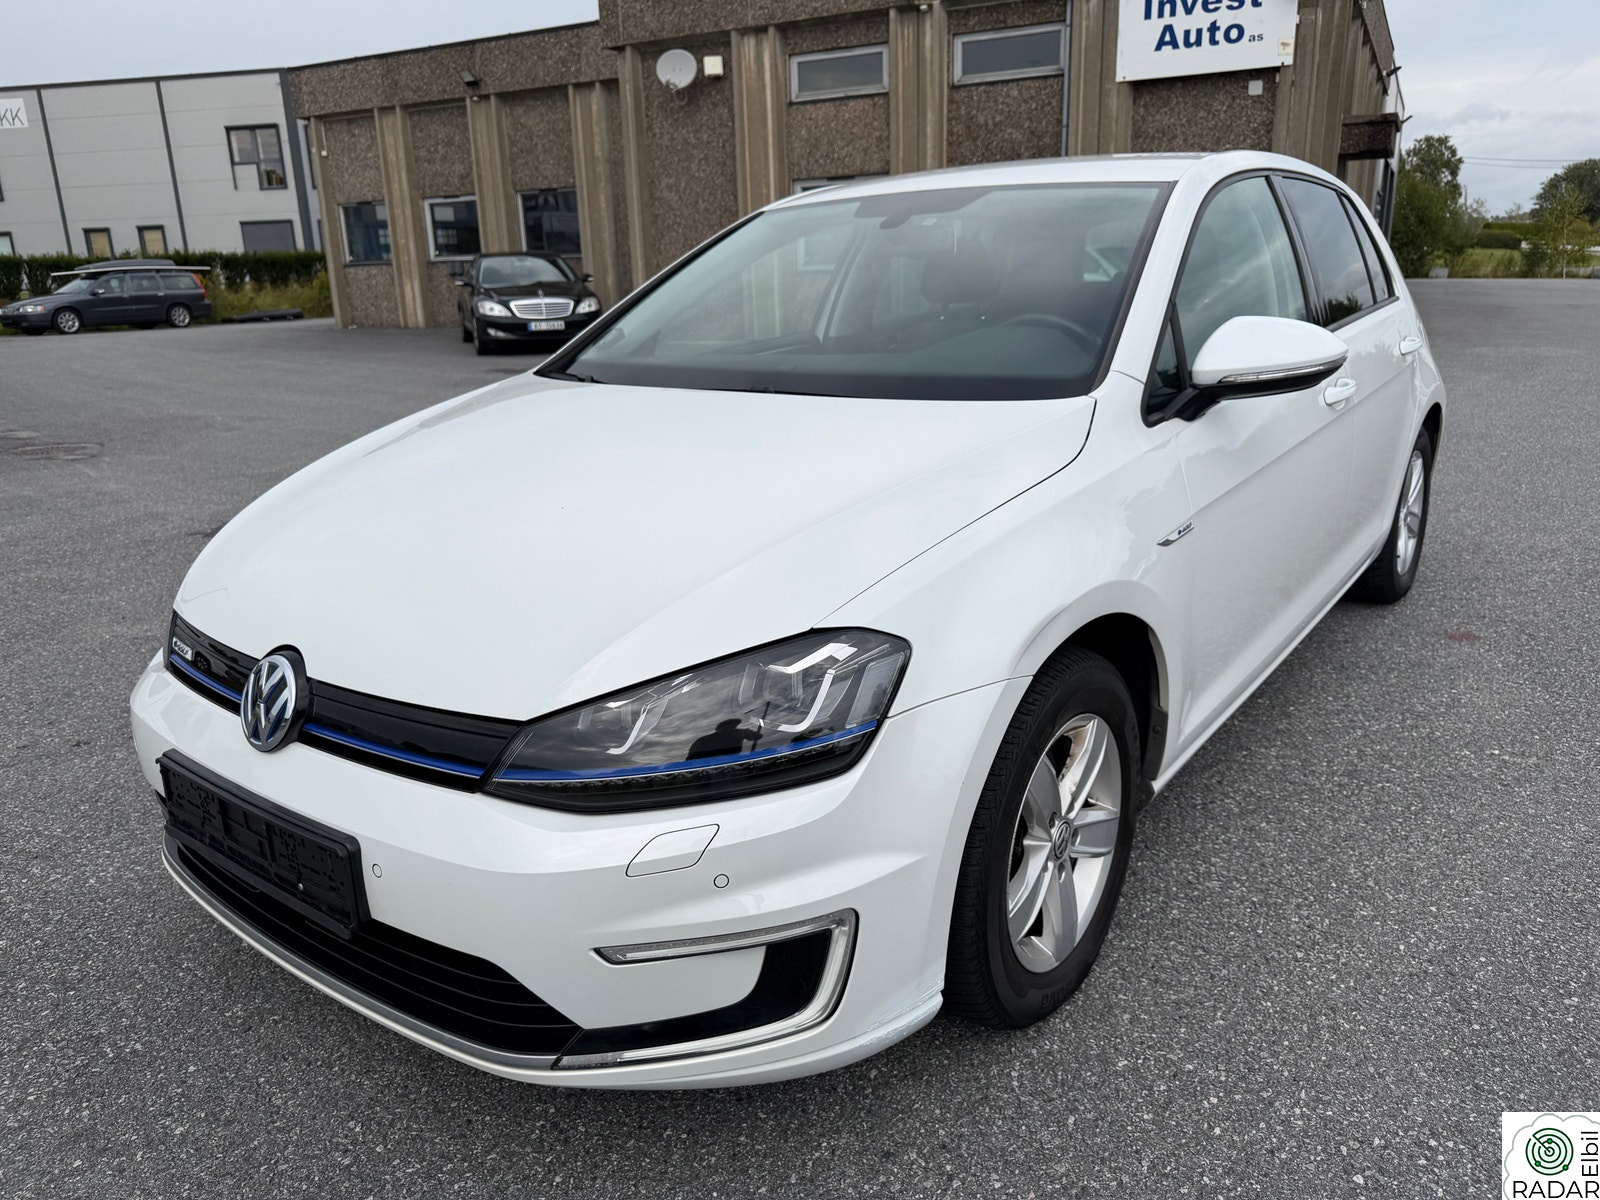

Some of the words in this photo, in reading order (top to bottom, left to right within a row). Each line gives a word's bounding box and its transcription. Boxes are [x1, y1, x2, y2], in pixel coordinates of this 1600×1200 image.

[1144, 0, 1262, 20] Inves
[1154, 19, 1245, 52] Auto
[1248, 34, 1264, 42] as
